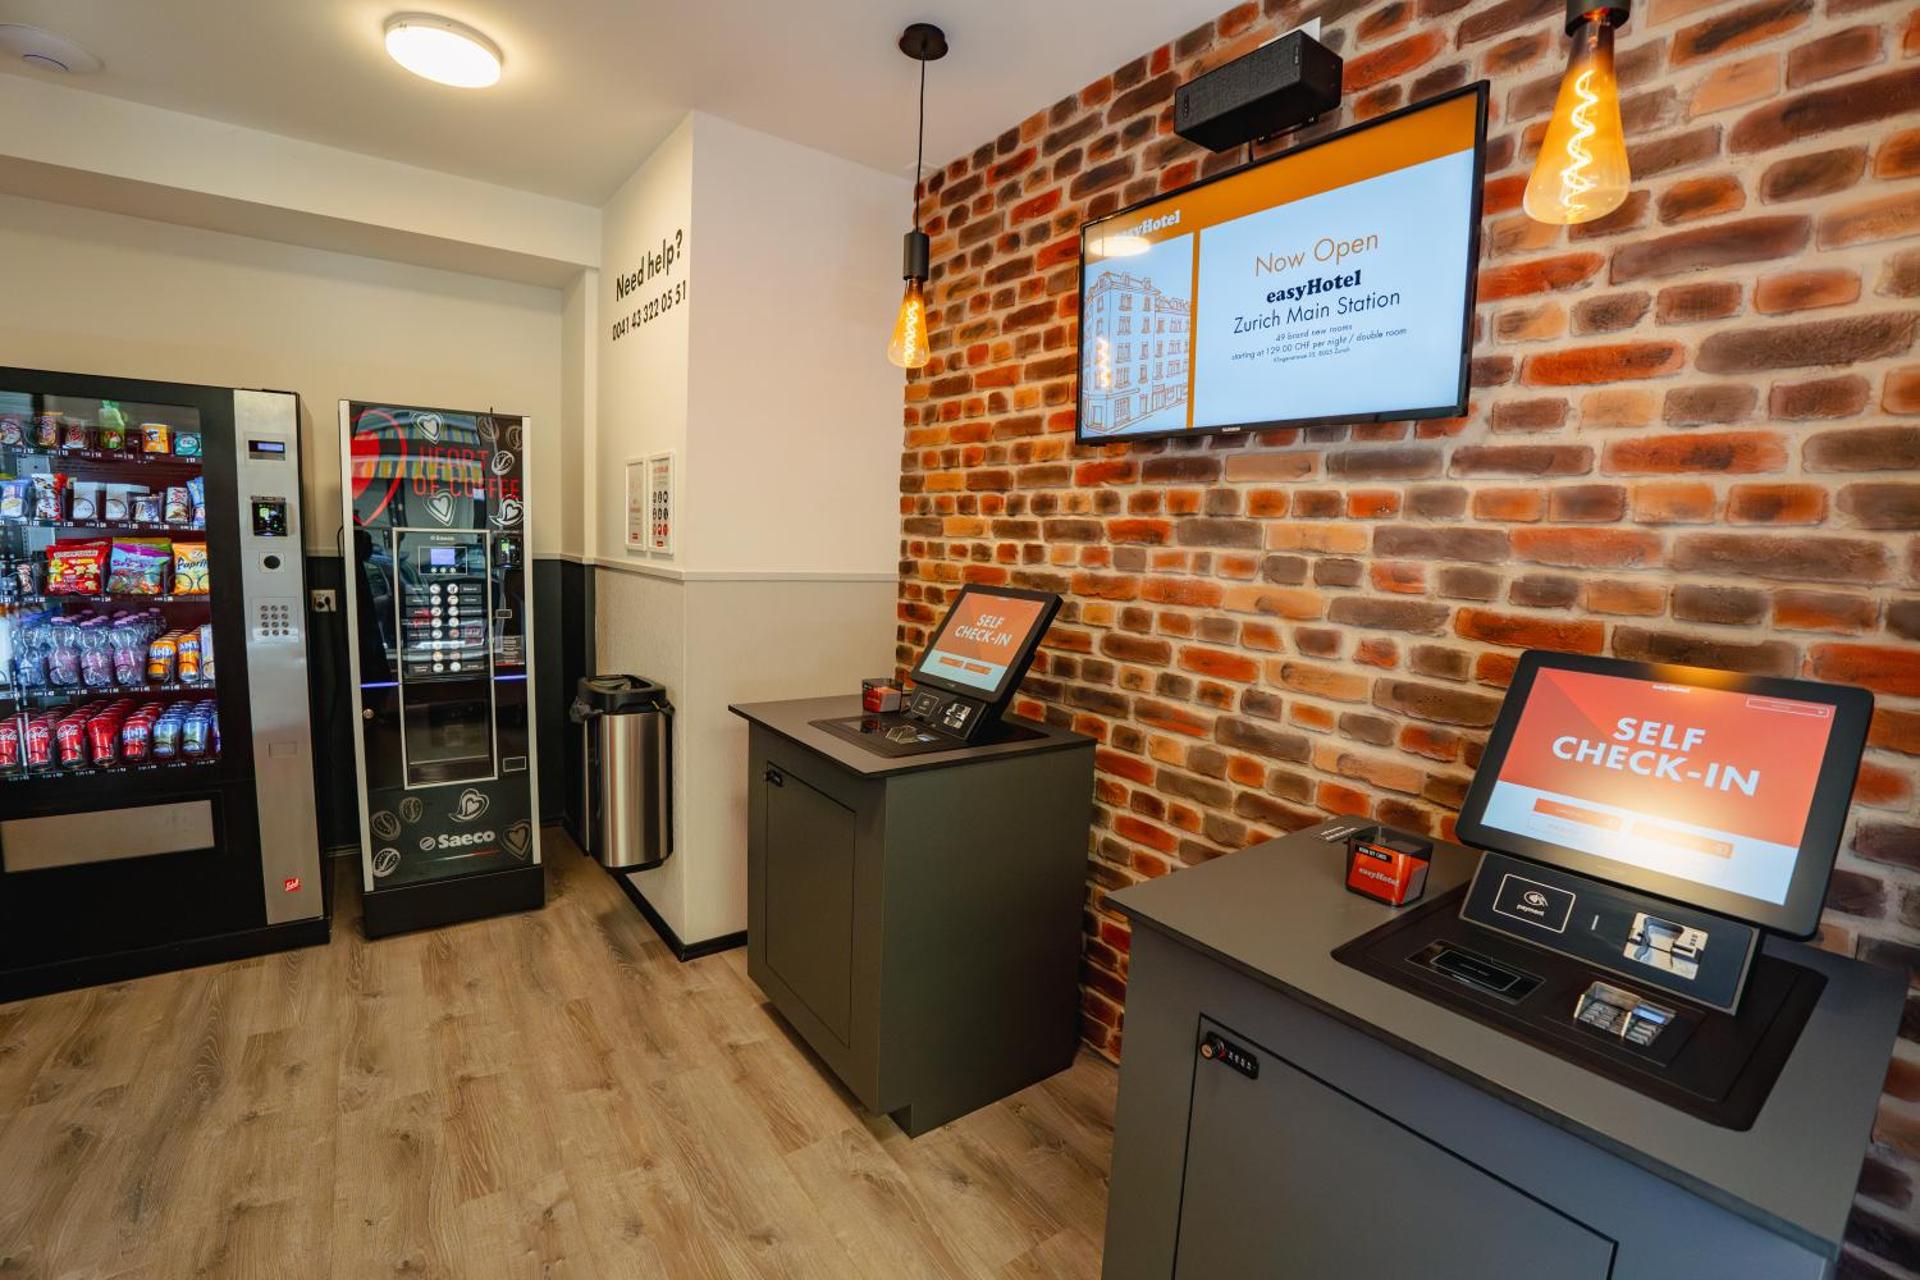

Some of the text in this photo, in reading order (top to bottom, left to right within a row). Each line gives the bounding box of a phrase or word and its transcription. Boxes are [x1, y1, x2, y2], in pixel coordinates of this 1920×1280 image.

[616, 228, 683, 303] Need help?
[1255, 234, 1378, 277] Now Open
[1266, 269, 1361, 303] easyHotel
[612, 279, 686, 341] 0041 43 322 05 51
[1233, 291, 1401, 334] Zurich Main Station
[1231, 350, 1255, 361] starting
[1256, 349, 1265, 357] at
[1294, 341, 1310, 351] CHF
[1312, 340, 1325, 350] per
[1326, 336, 1348, 348] night
[1355, 330, 1384, 342] double
[1385, 328, 1408, 337] room
[1287, 329, 1309, 340] brand
[1311, 328, 1327, 337] new
[1329, 324, 1353, 333] rooms
[413, 474, 521, 500] OF COFFEE
[954, 625, 1013, 647] CHECK-IN
[977, 614, 1005, 629] SELF
[1612, 717, 1706, 753] SELF
[1552, 735, 1761, 797] CHECK-IN
[438, 830, 496, 849] Saeco
[1358, 866, 1400, 888] easyHotel
[1516, 903, 1545, 918] payment
